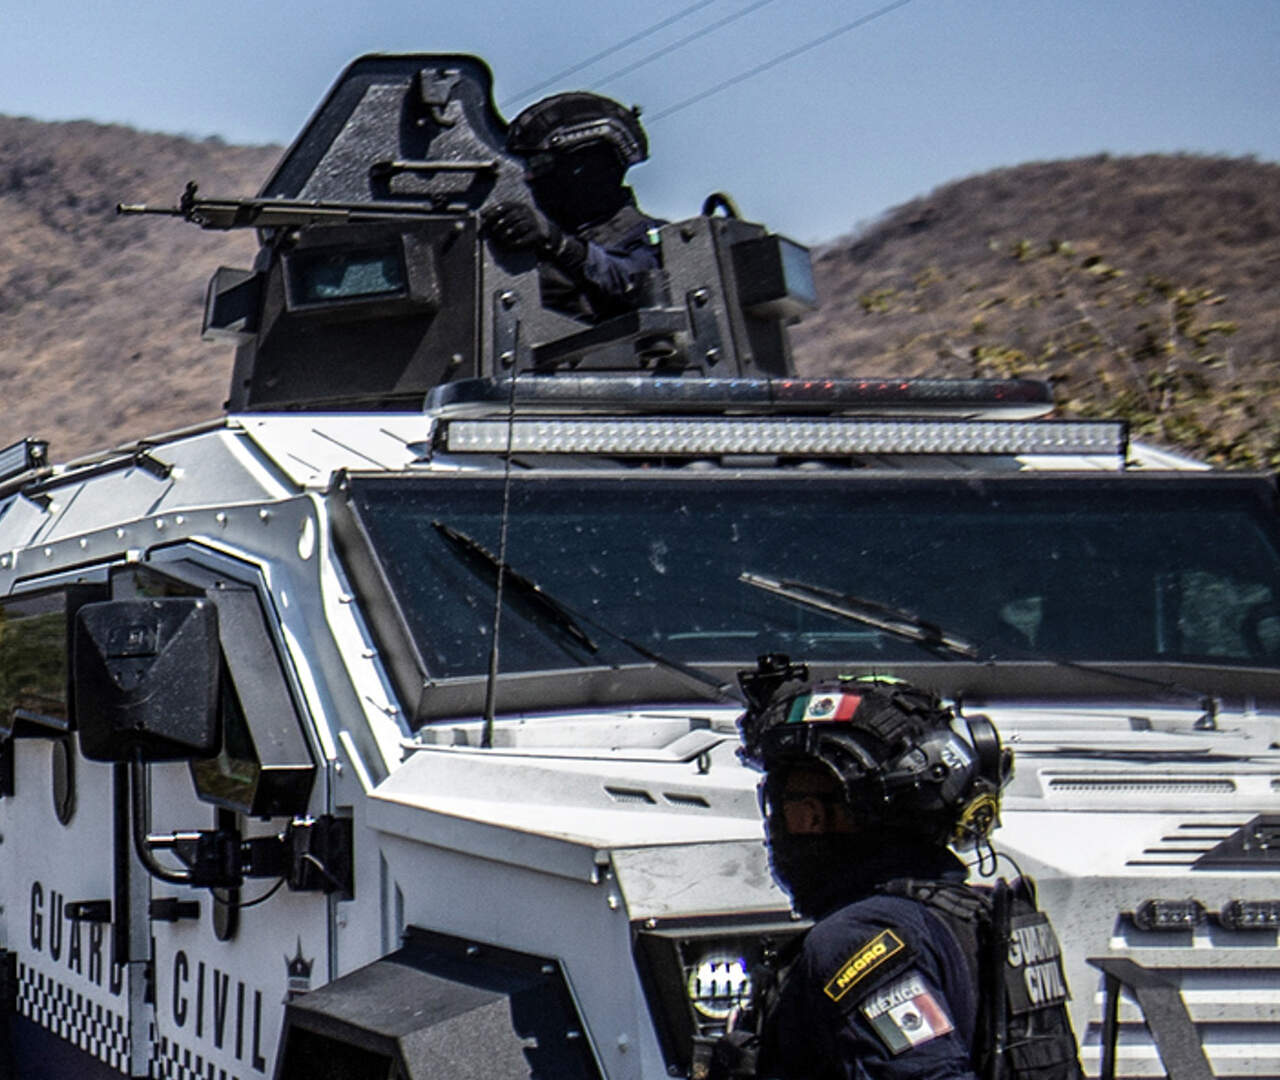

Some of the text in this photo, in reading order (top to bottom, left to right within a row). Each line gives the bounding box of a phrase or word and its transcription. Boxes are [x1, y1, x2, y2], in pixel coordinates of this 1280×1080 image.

[836, 942, 888, 988] NEGRO
[1024, 961, 1067, 1004] CIVIL
[173, 950, 266, 1074] CIVIL
